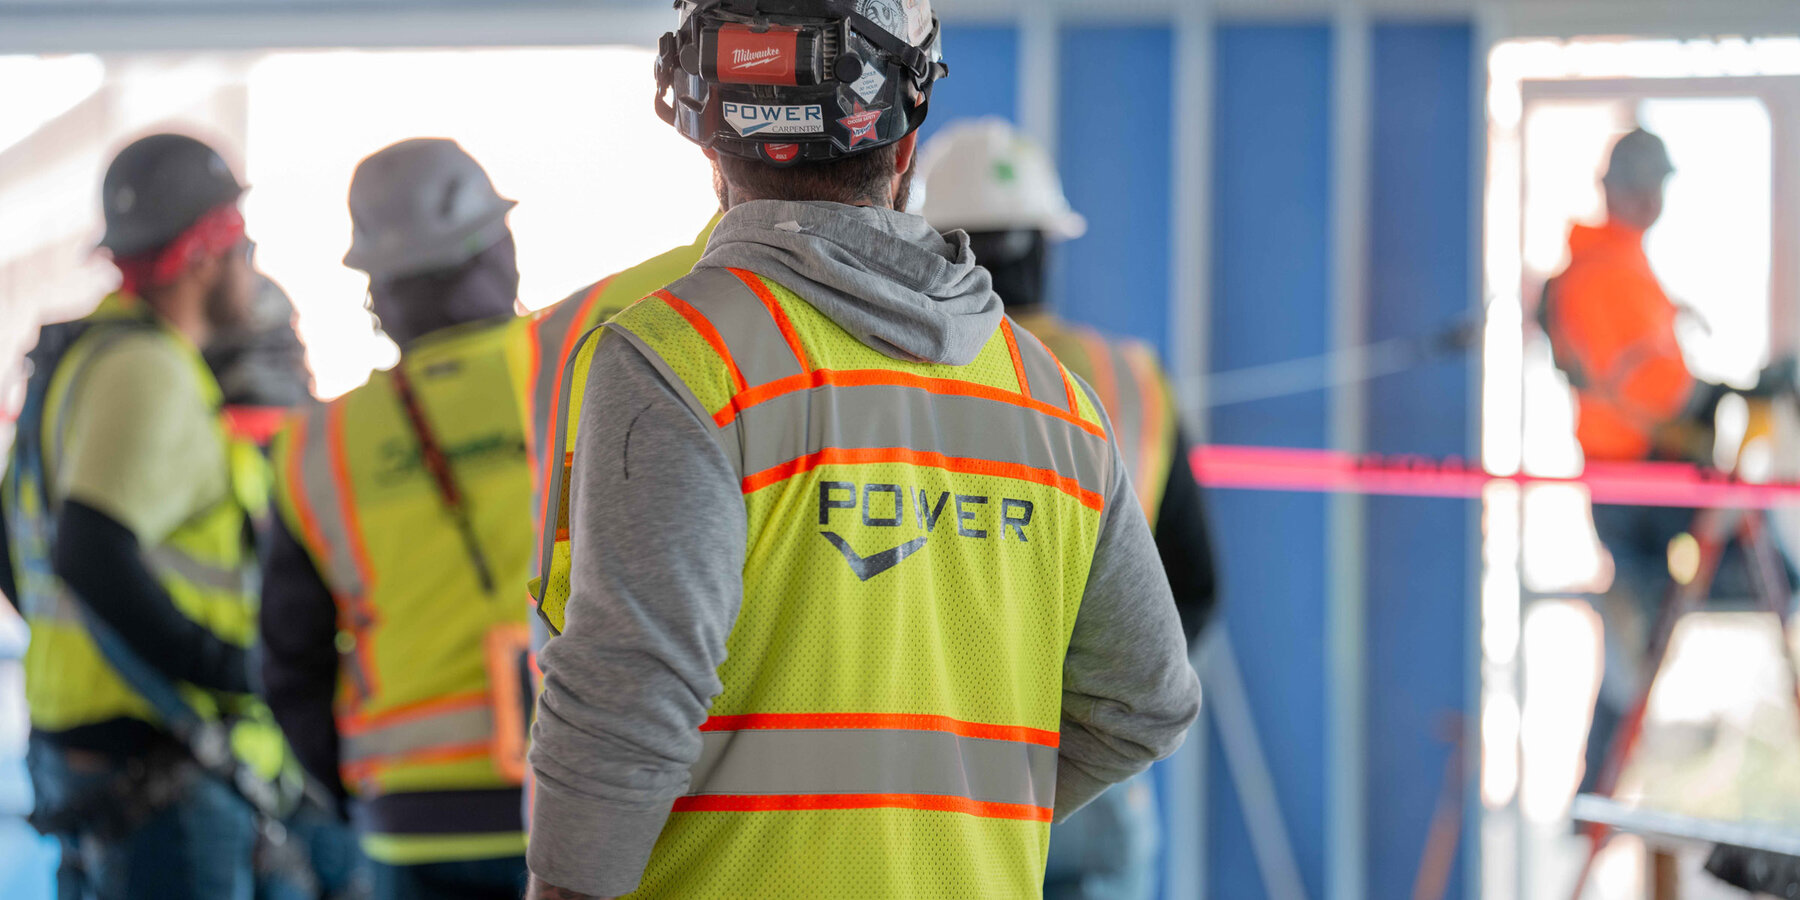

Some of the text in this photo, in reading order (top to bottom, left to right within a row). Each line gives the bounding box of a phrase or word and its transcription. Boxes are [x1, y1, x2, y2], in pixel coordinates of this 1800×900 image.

[732, 46, 779, 64] Milwaukee
[724, 103, 822, 121] POWER
[772, 125, 822, 133] CARPENTRY
[818, 480, 1035, 543] POWER
